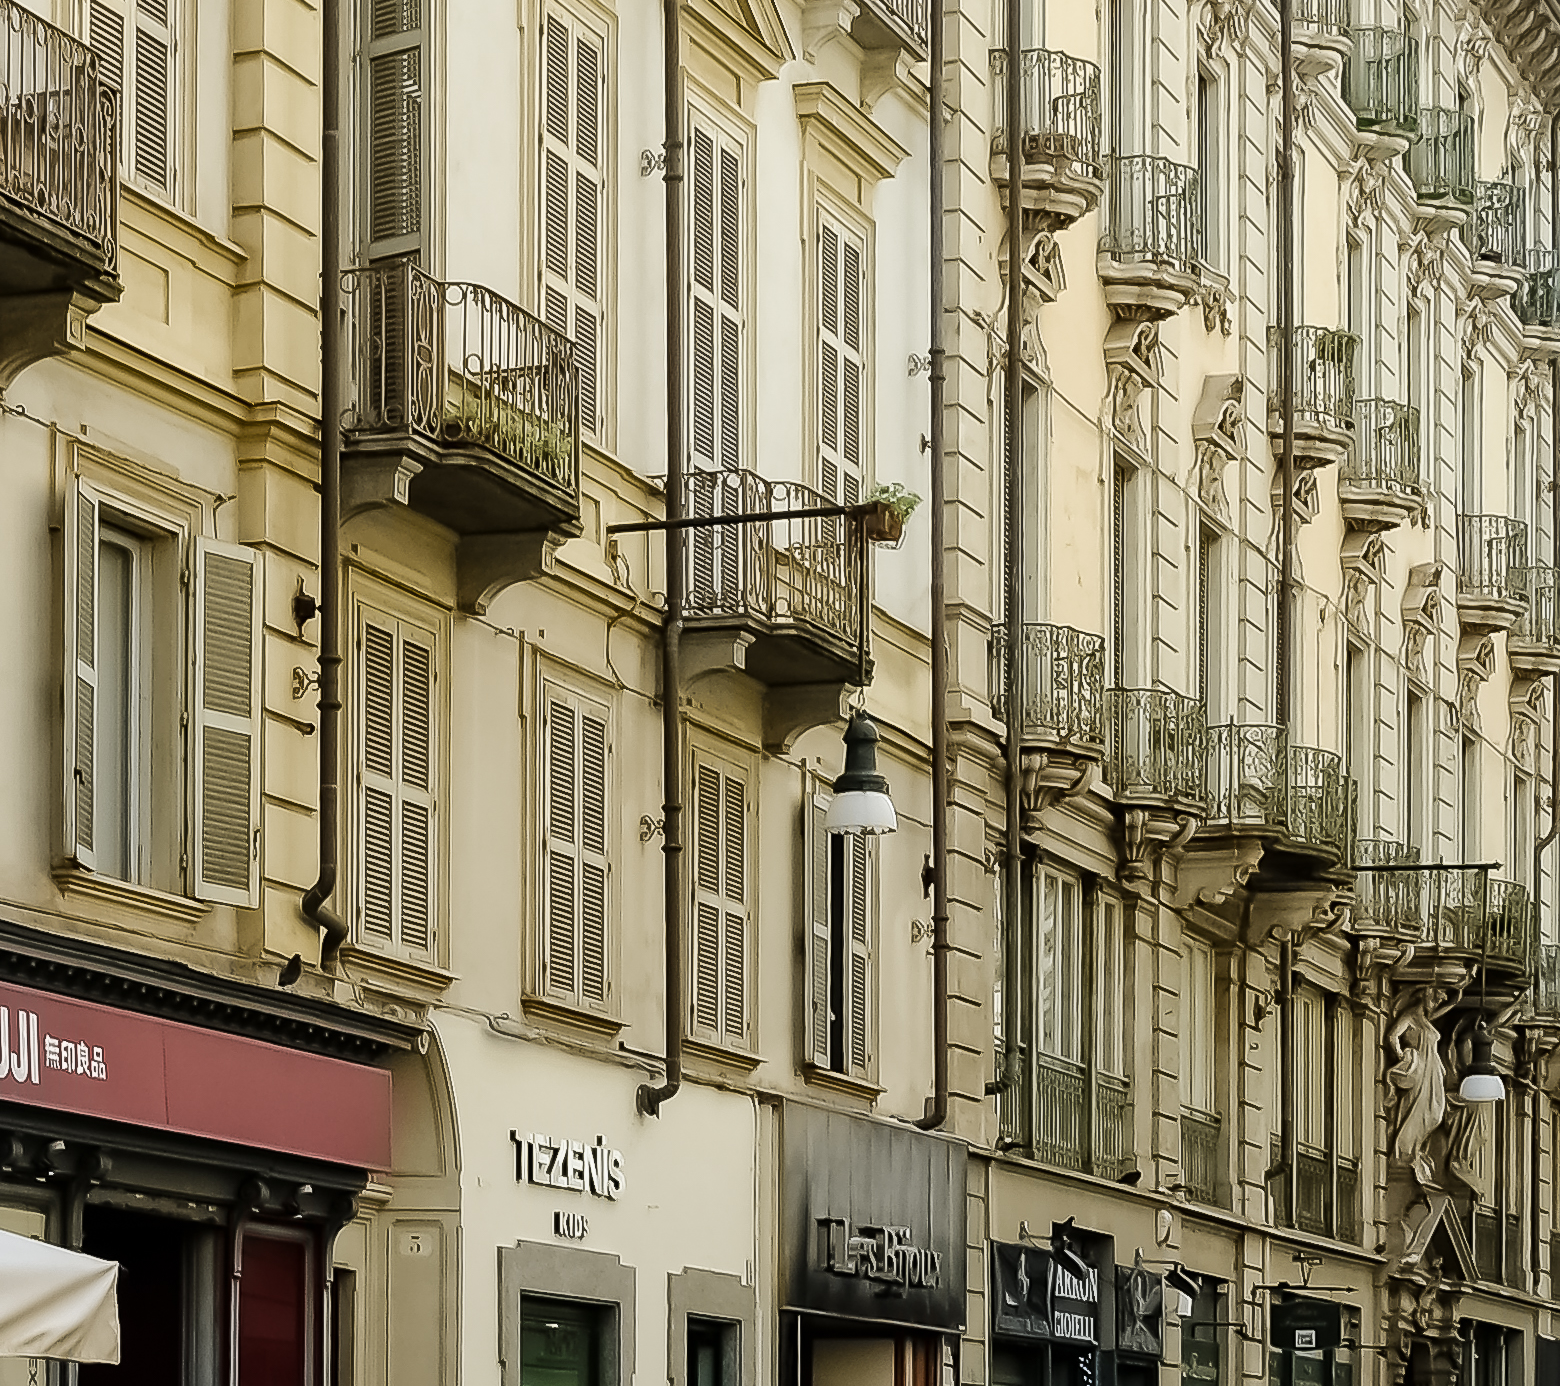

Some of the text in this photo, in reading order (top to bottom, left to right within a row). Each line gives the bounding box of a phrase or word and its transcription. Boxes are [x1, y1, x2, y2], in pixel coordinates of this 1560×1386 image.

[44, 1033, 108, 1081] 無印良品
[552, 1211, 590, 1240] KIDS
[1054, 1310, 1095, 1342] GIOIELLI
